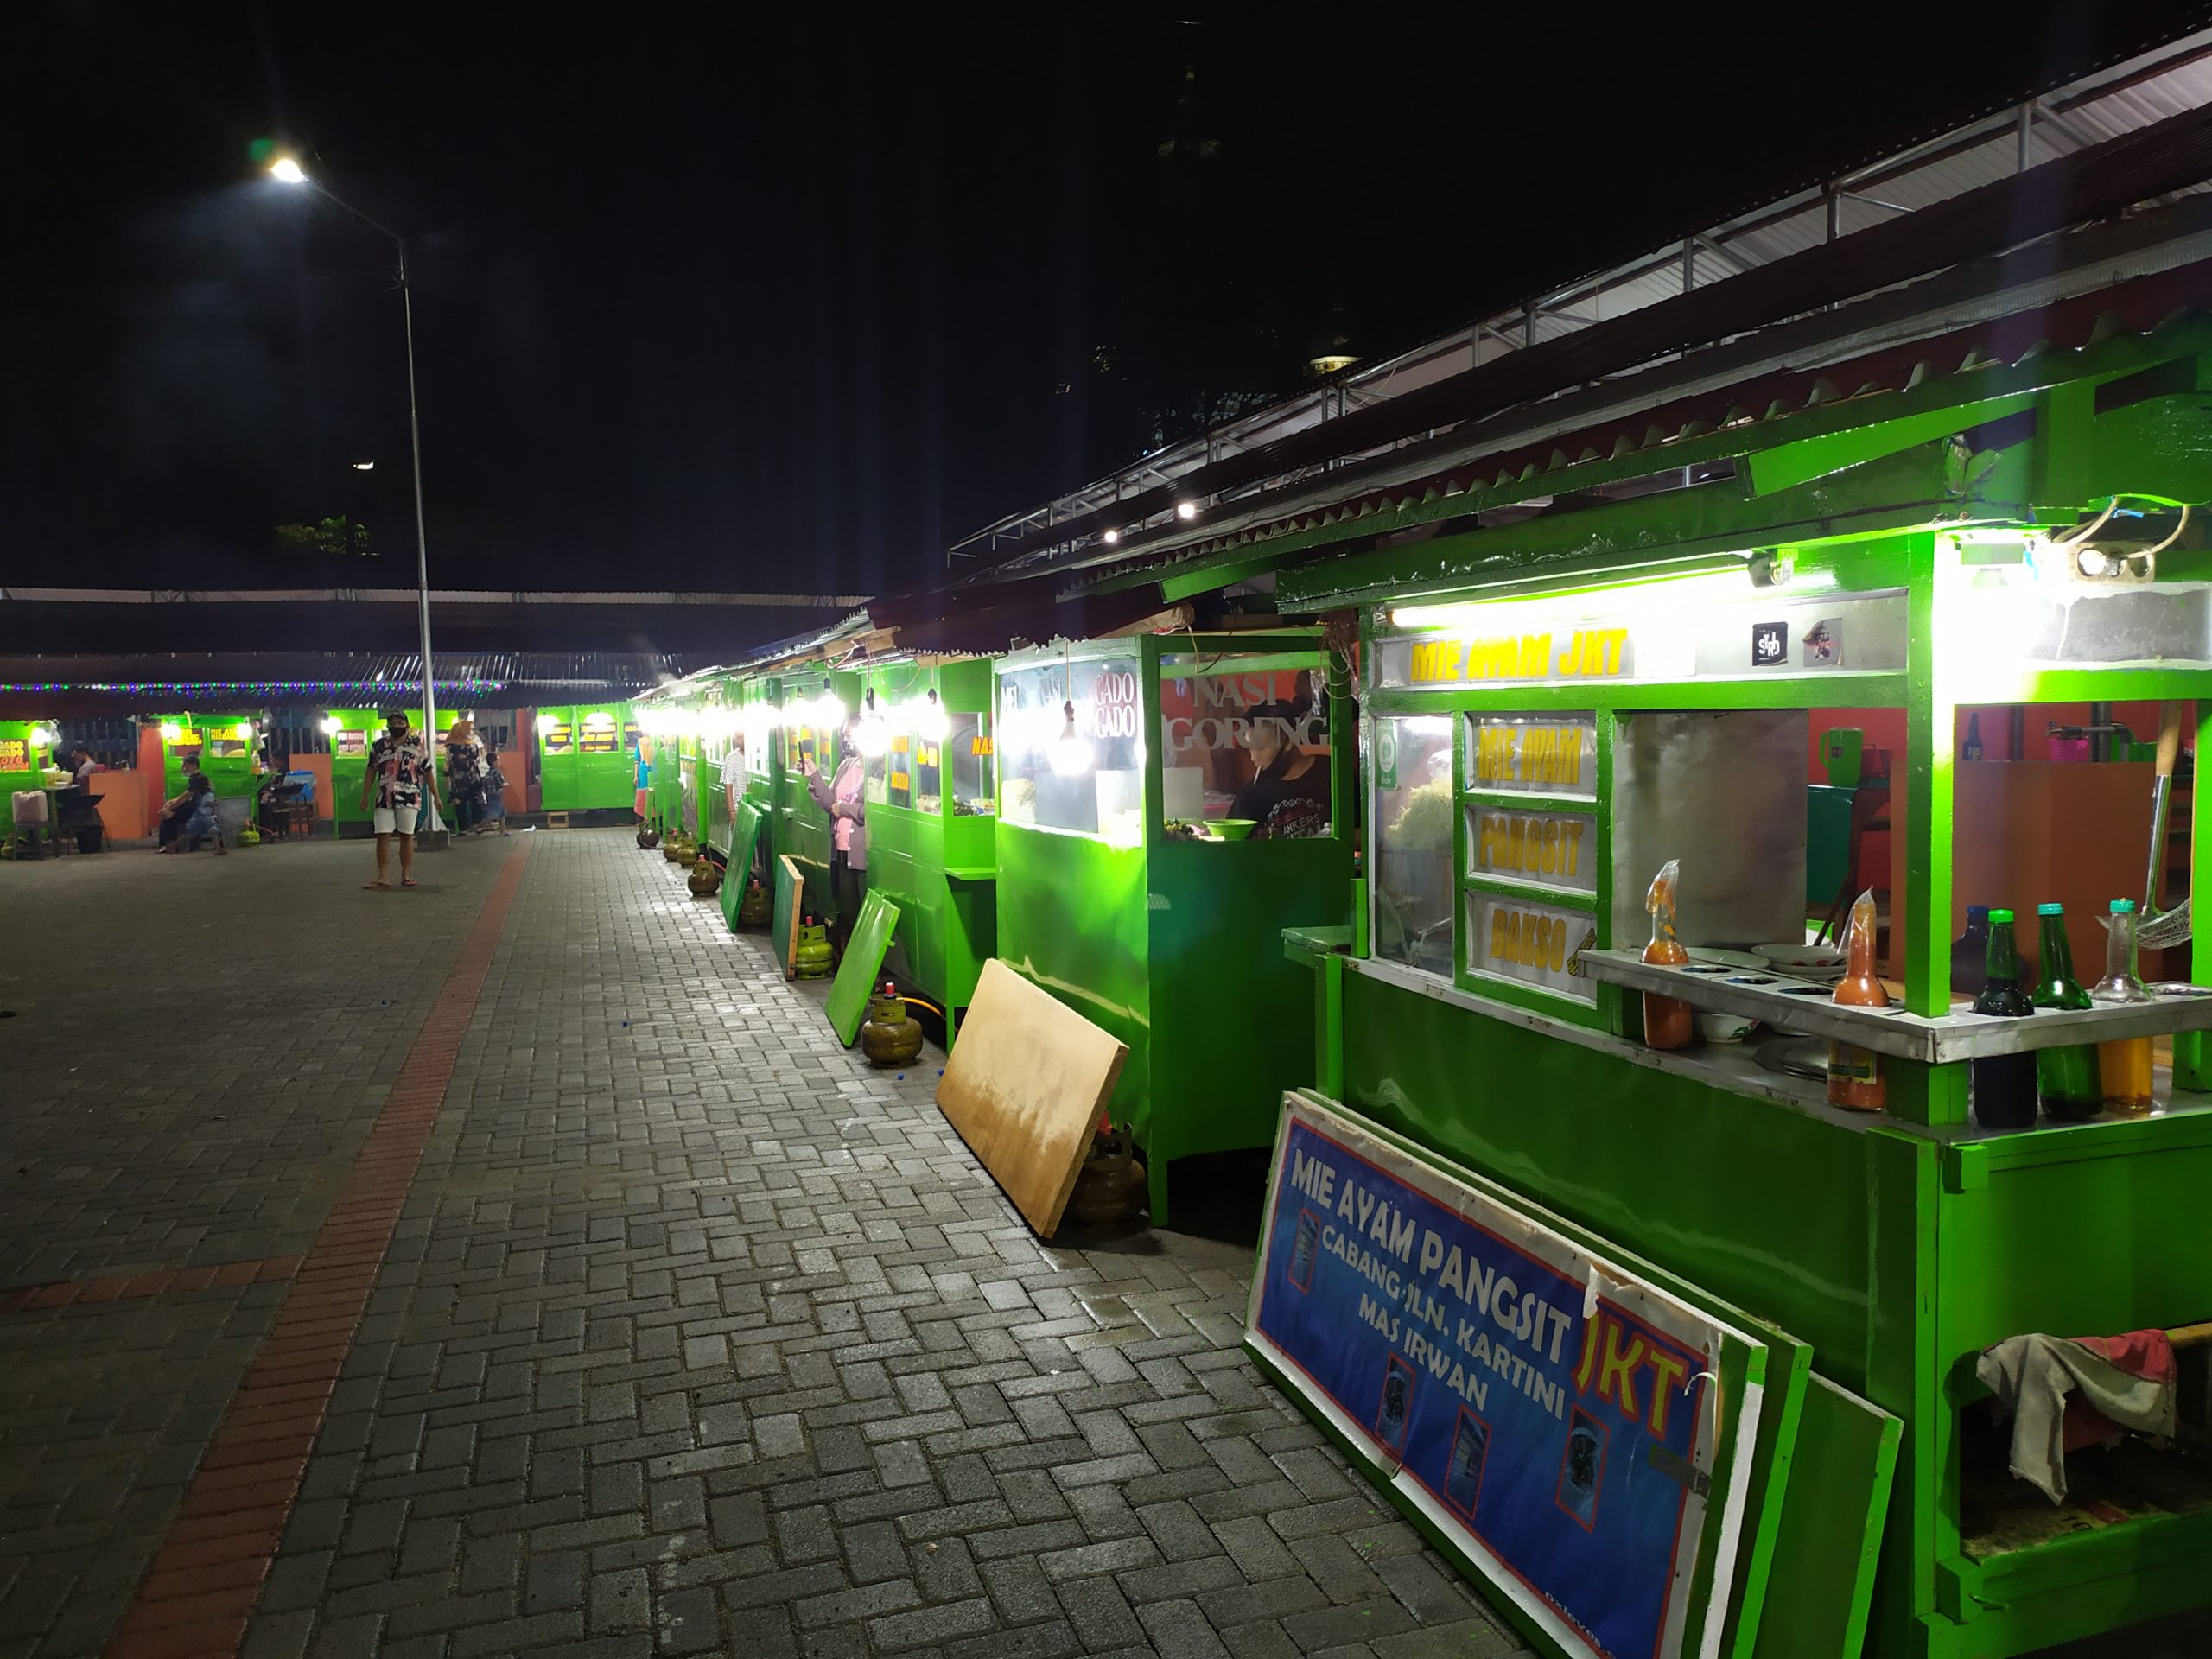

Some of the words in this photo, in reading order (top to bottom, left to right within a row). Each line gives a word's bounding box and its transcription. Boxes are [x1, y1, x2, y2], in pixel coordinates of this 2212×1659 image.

[1410, 639, 1462, 682] MIE
[1467, 632, 1552, 679] AYAM
[1558, 628, 1628, 677] JKT
[1096, 671, 1135, 706] GADO
[1193, 674, 1277, 708] NASI
[971, 735, 994, 756] NAS
[1096, 704, 1135, 740] GADO
[1166, 716, 1330, 752] GORENG
[1478, 728, 1516, 782] MIE
[1521, 728, 1583, 785] AYAM
[1478, 816, 1584, 877] PANGSIT
[1490, 908, 1567, 973] BAKSO
[1291, 1148, 1336, 1210] MIE
[1337, 1179, 1416, 1264] AYAM
[1419, 1229, 1573, 1364] PANGSIT
[1573, 1309, 1688, 1440] JKT
[1322, 1224, 1401, 1300] CABANG
[1404, 1281, 1450, 1337] JLN.
[1456, 1318, 1566, 1421] KARTINI
[1358, 1292, 1401, 1343] MAS
[1403, 1326, 1488, 1412] IRWAN
